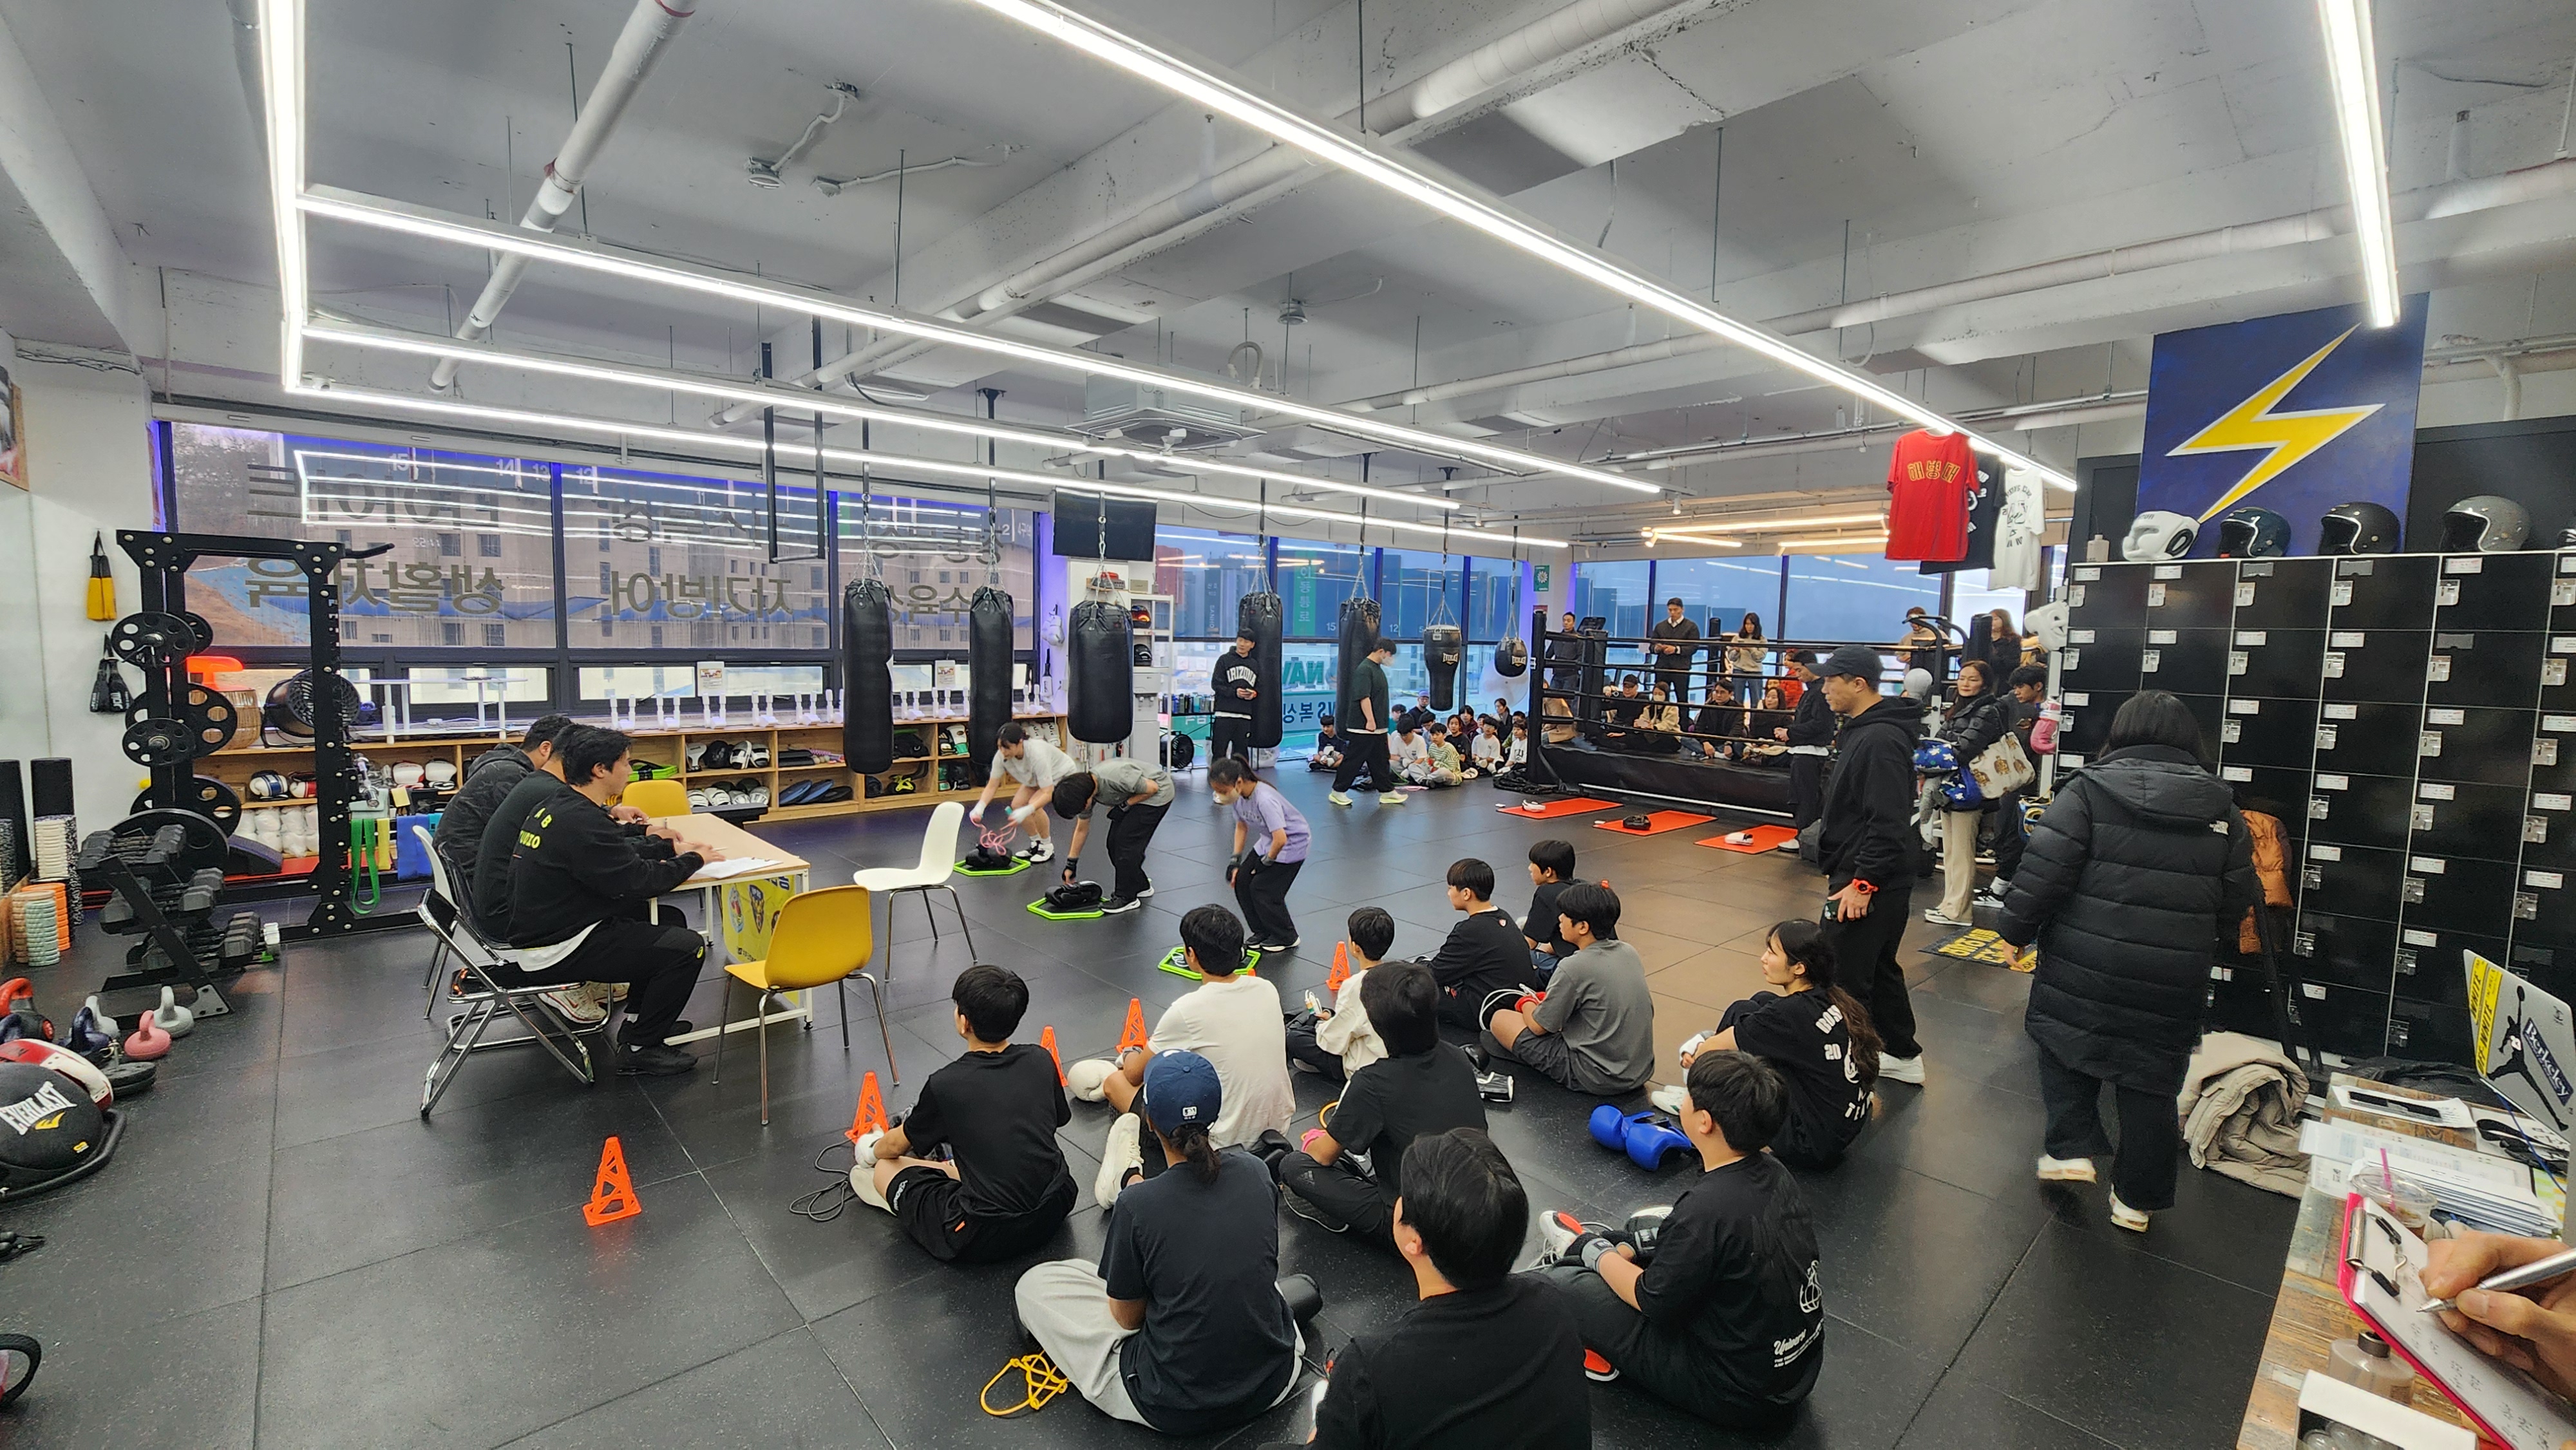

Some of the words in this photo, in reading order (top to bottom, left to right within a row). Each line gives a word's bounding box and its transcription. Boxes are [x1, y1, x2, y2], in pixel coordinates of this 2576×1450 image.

[1907, 460, 1960, 483] 해병대
[1824, 1044, 1842, 1060] 20
[2525, 1021, 2570, 1097] Berkeley
[0, 1080, 78, 1136] EVERLAST
